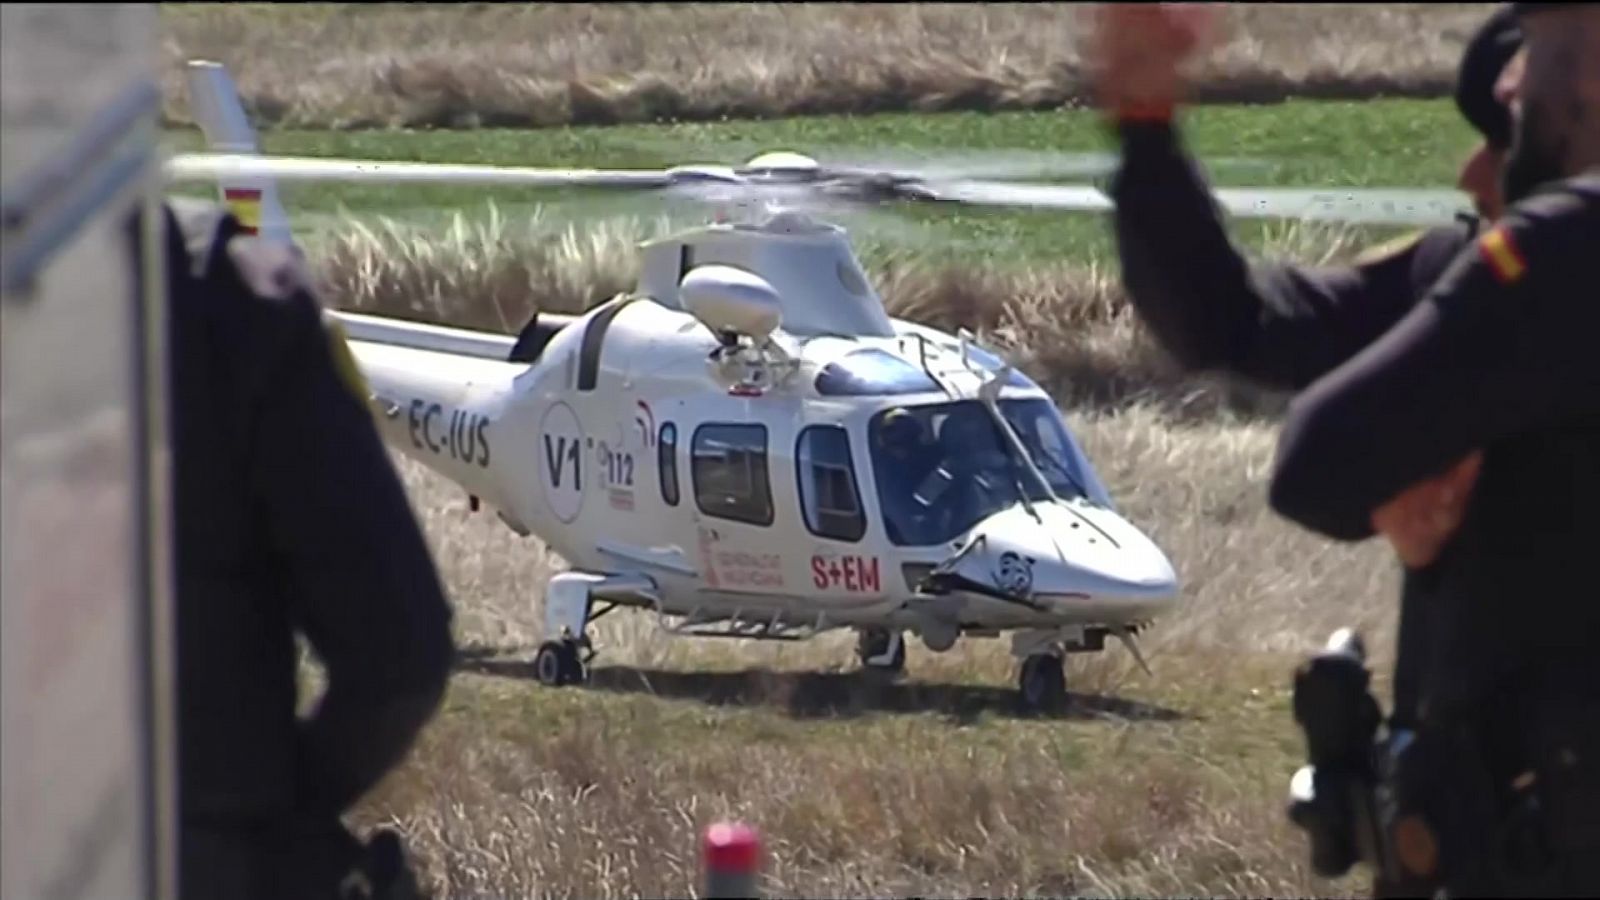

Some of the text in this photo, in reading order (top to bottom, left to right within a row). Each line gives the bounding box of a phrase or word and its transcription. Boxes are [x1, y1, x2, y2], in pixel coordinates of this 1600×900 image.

[408, 400, 490, 468] EC-IUS
[545, 433, 581, 491] V1
[607, 452, 634, 486] 112
